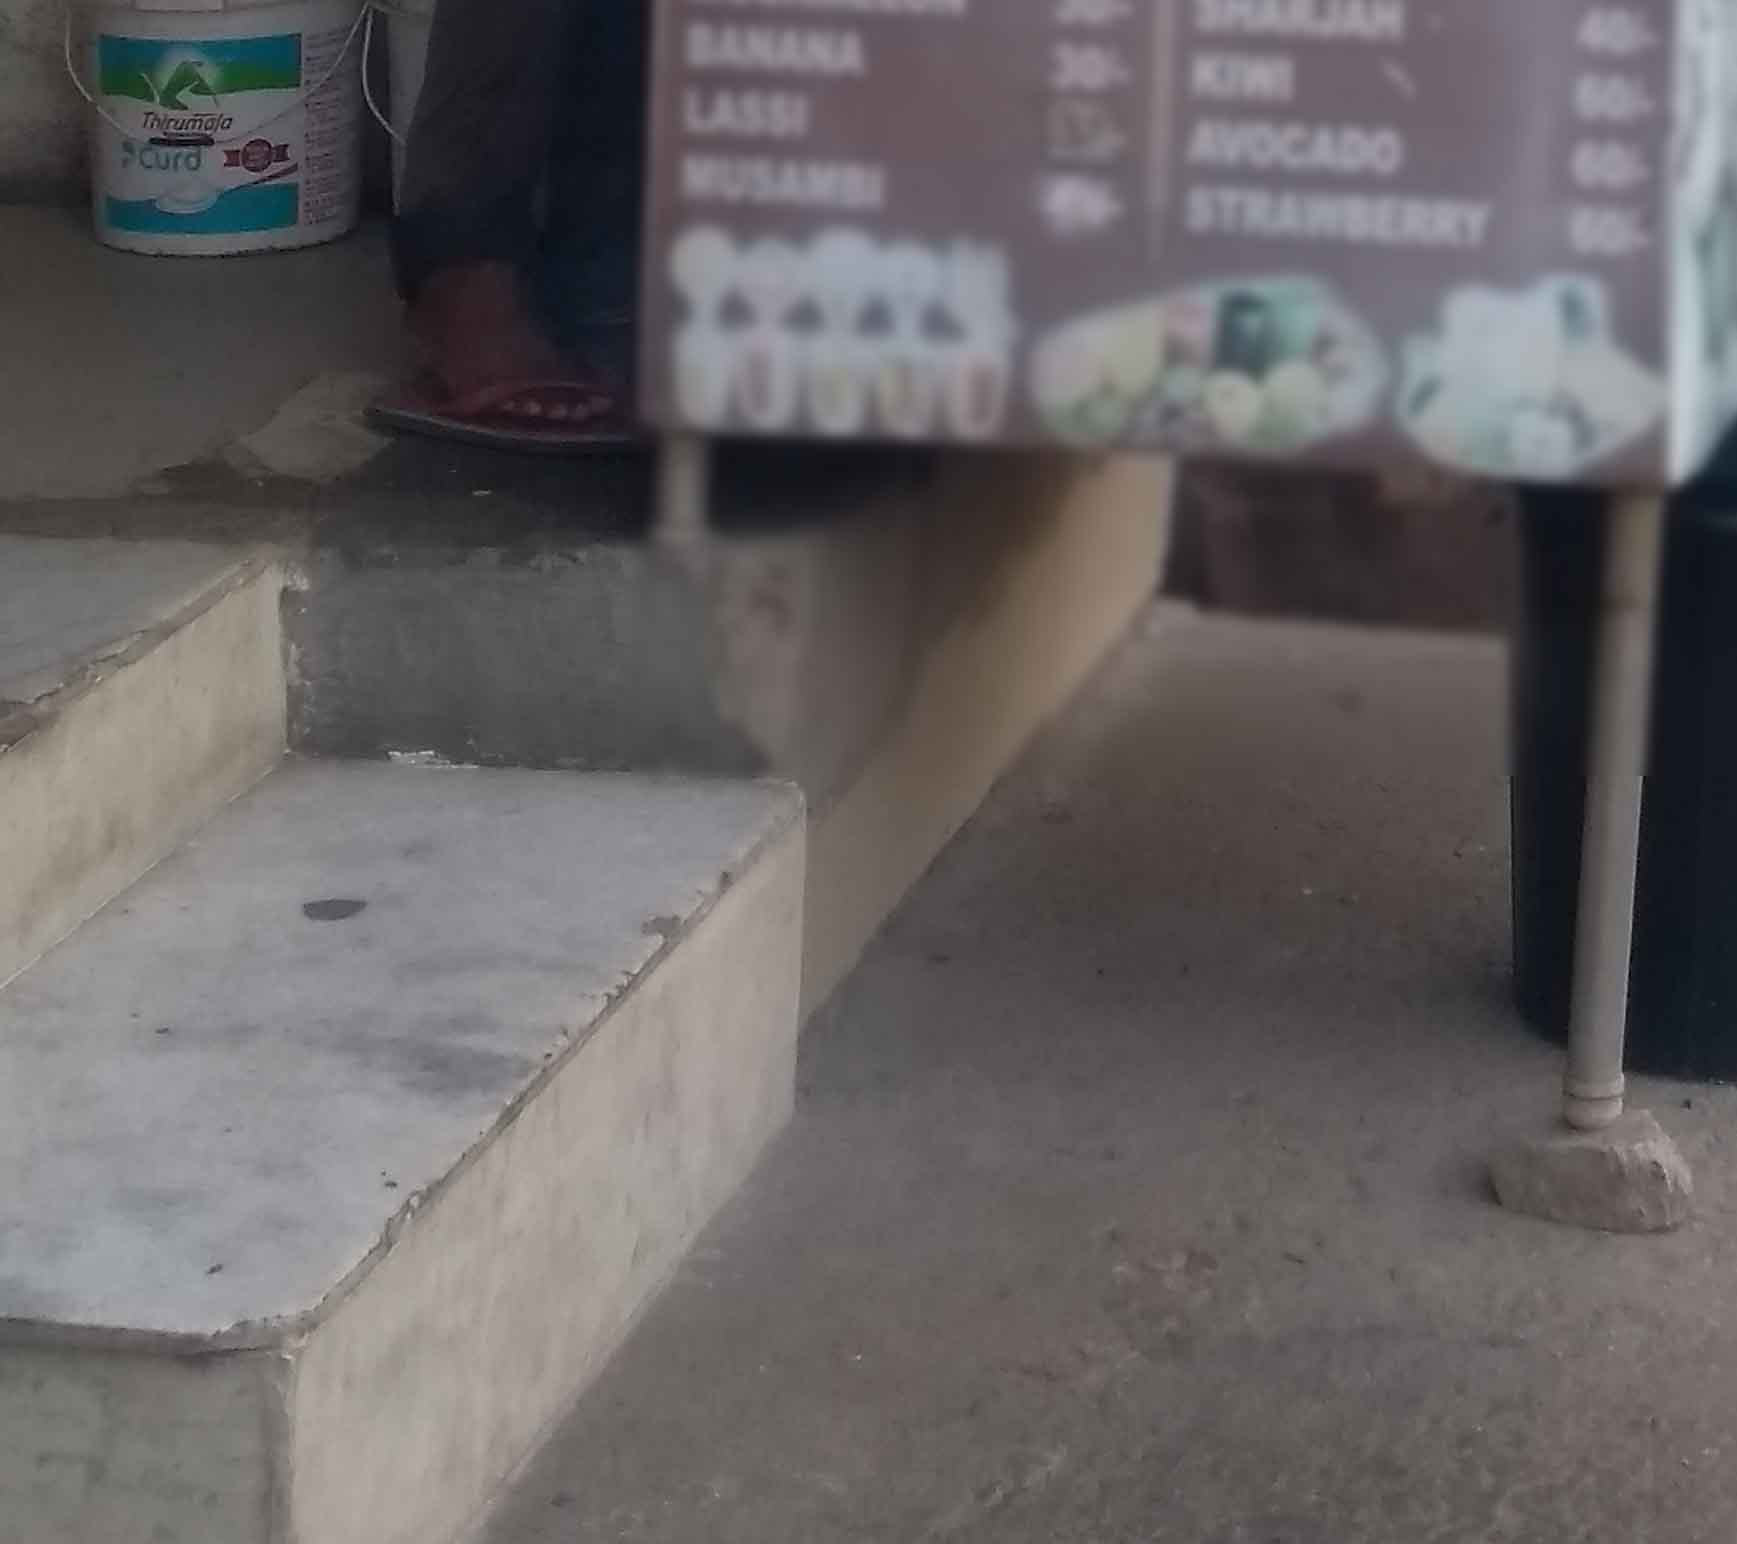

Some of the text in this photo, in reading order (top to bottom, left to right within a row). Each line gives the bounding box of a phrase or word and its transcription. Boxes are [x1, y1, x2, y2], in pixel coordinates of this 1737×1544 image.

[685, 25, 867, 77] BANANA
[1191, 53, 1296, 102] KIWI
[683, 90, 811, 141] LASSI
[1186, 118, 1404, 176] AVOCADO
[1185, 184, 1490, 246] STRAWBERRY
